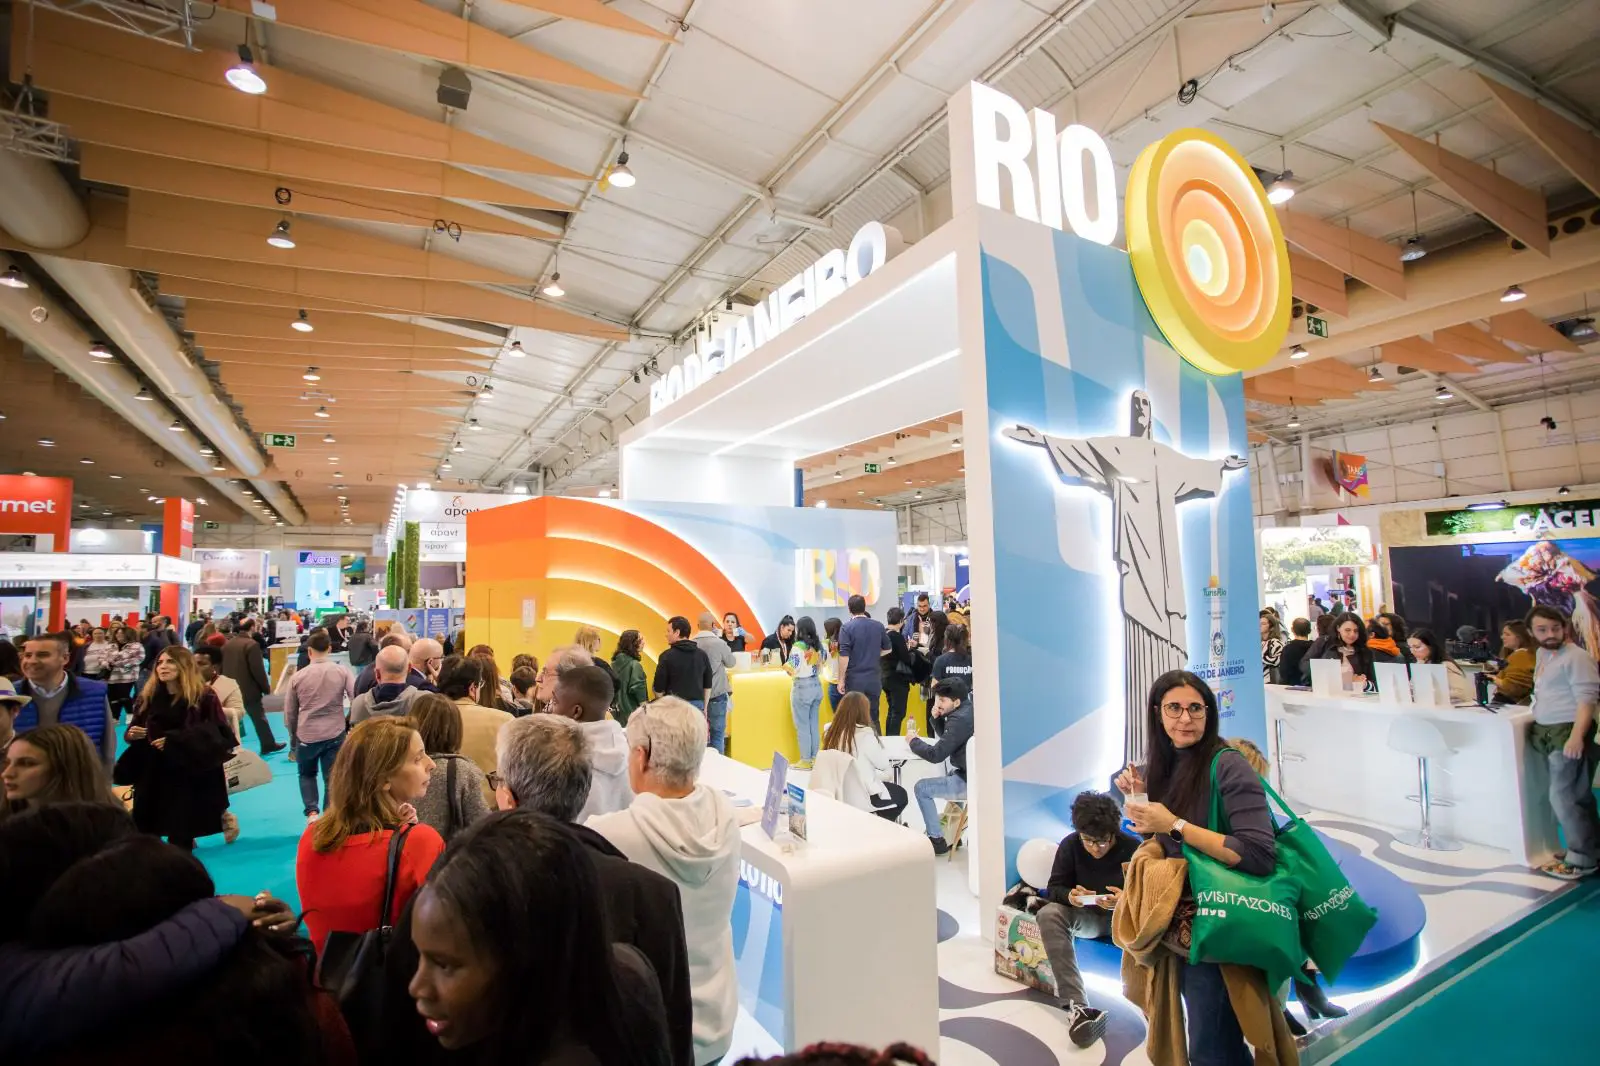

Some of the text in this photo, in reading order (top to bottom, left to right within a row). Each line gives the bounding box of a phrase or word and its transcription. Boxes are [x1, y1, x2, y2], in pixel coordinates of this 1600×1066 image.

[971, 80, 1118, 246] RIO
[650, 365, 684, 416] RIO
[724, 220, 887, 371] JANEIRO
[0, 499, 57, 514] met
[795, 547, 881, 608] RIO
[1206, 668, 1217, 679] DE
[1217, 665, 1245, 677] JANEIRO
